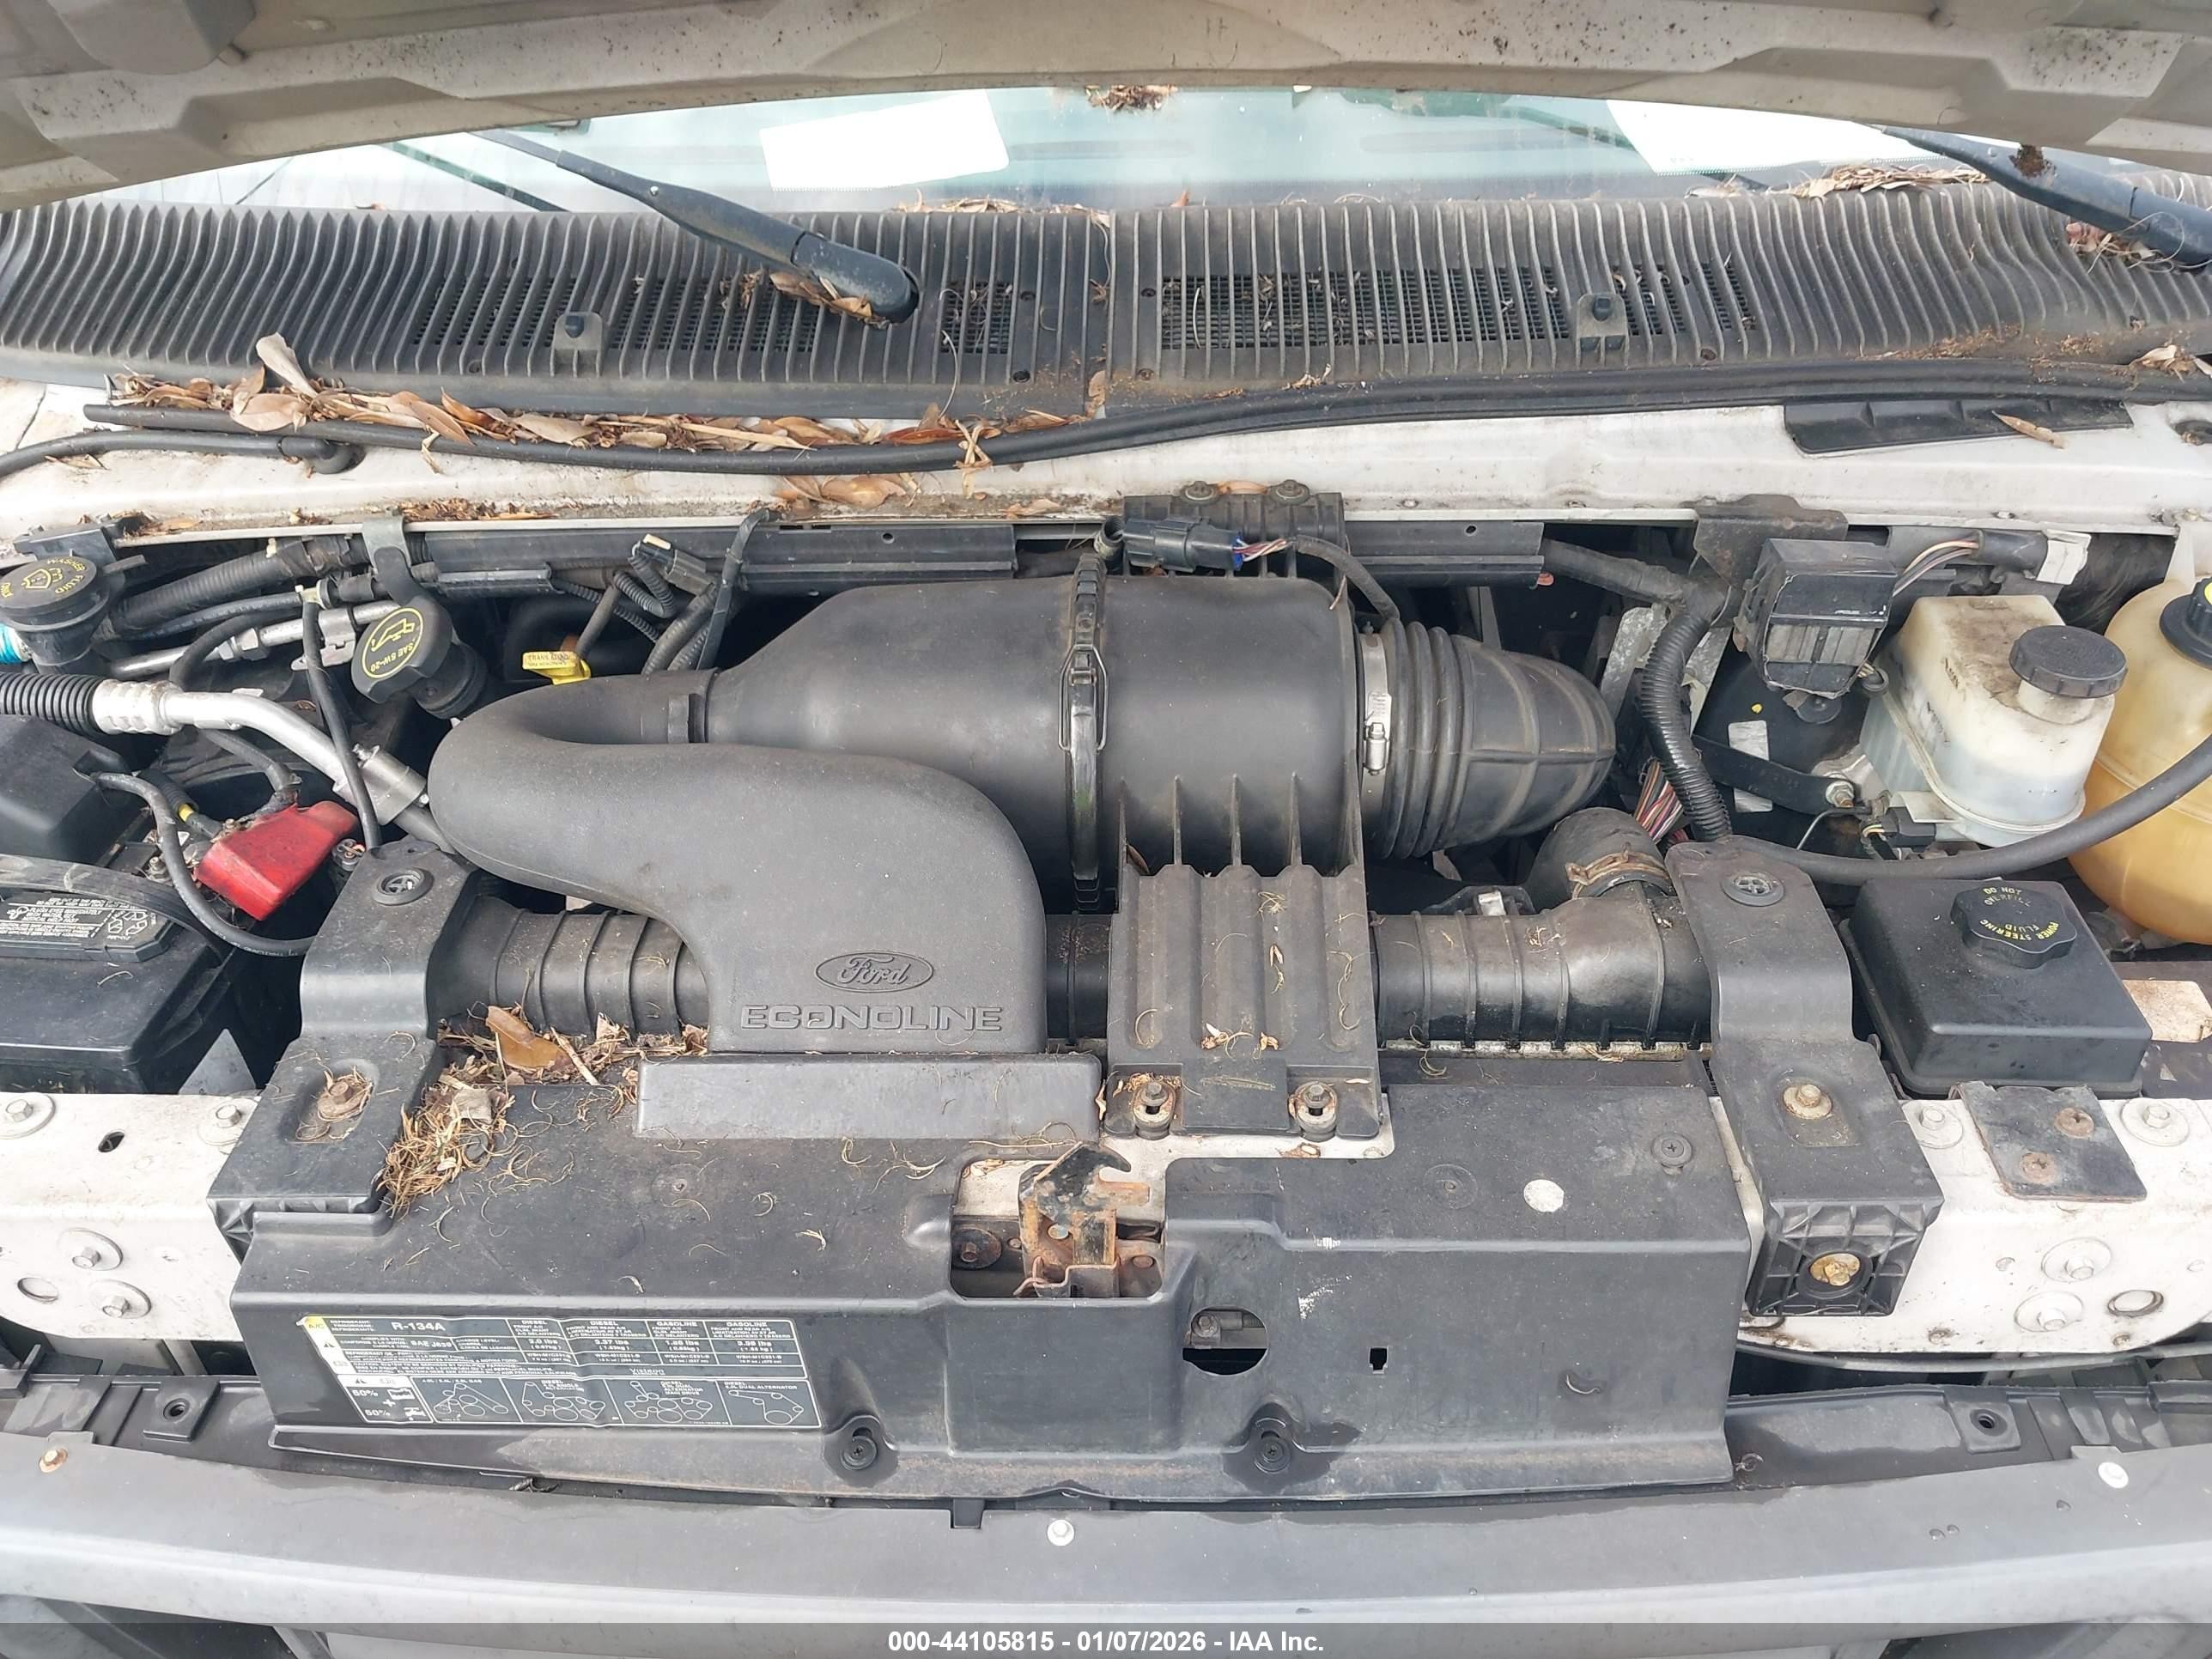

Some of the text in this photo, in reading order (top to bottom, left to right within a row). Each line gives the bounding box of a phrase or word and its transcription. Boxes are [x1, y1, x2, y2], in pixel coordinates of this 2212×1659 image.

[47, 558, 86, 594] WASHER FLUID
[370, 641, 415, 672] SAE 5W-20
[2001, 886, 2023, 895] NOT
[1979, 919, 2059, 941] POWER STEERING
[2005, 923, 2040, 933] FLUID
[837, 953, 911, 985] Ford
[740, 1004, 1004, 1031] ECONOLINE
[391, 1322, 447, 1331] R-134A
